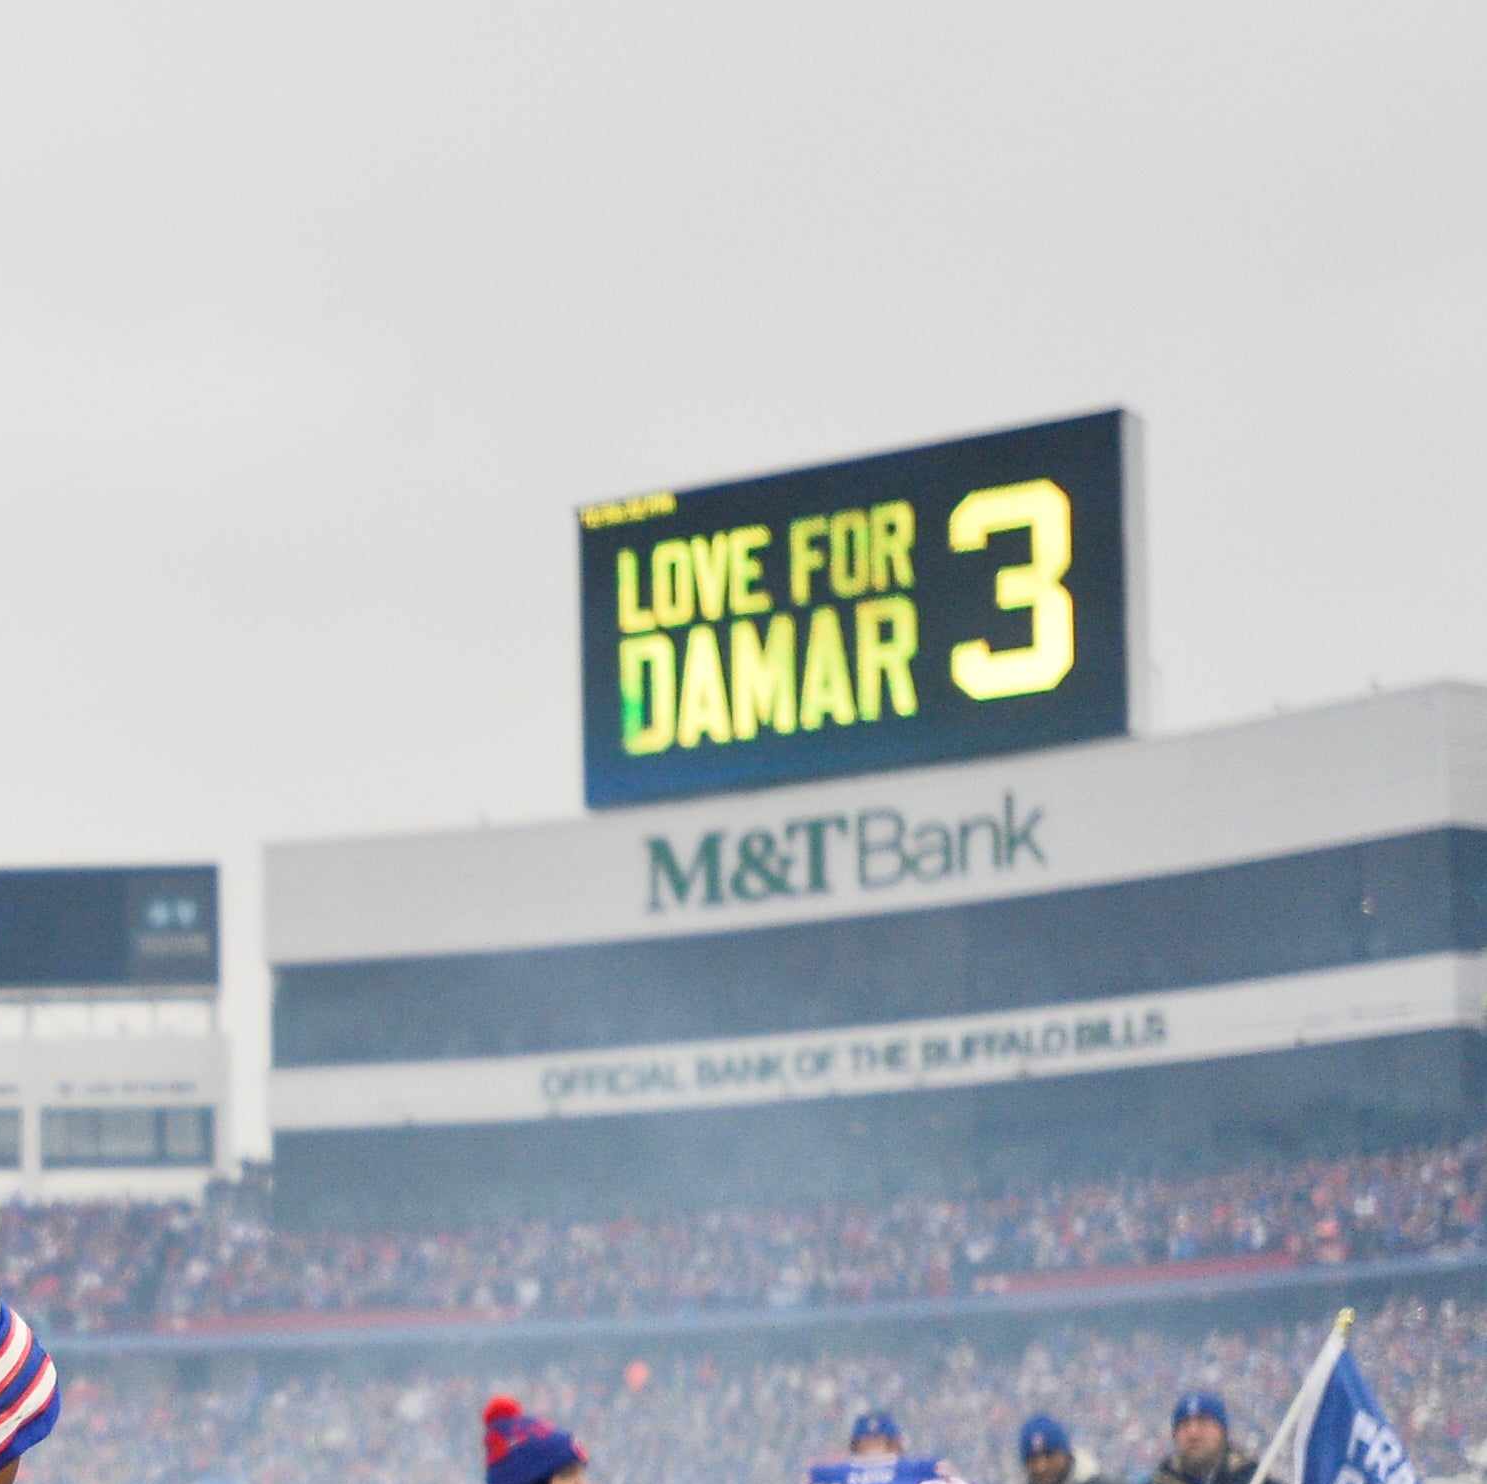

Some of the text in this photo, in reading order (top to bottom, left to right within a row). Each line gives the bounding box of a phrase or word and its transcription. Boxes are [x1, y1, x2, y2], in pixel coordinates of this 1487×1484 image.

[618, 500, 915, 635] LOVE FOR
[949, 476, 1074, 702] 3
[621, 597, 919, 756] DAMAR
[540, 1007, 1166, 1098] OFFICIAL BANK OF THE BUFFALO BILLS
